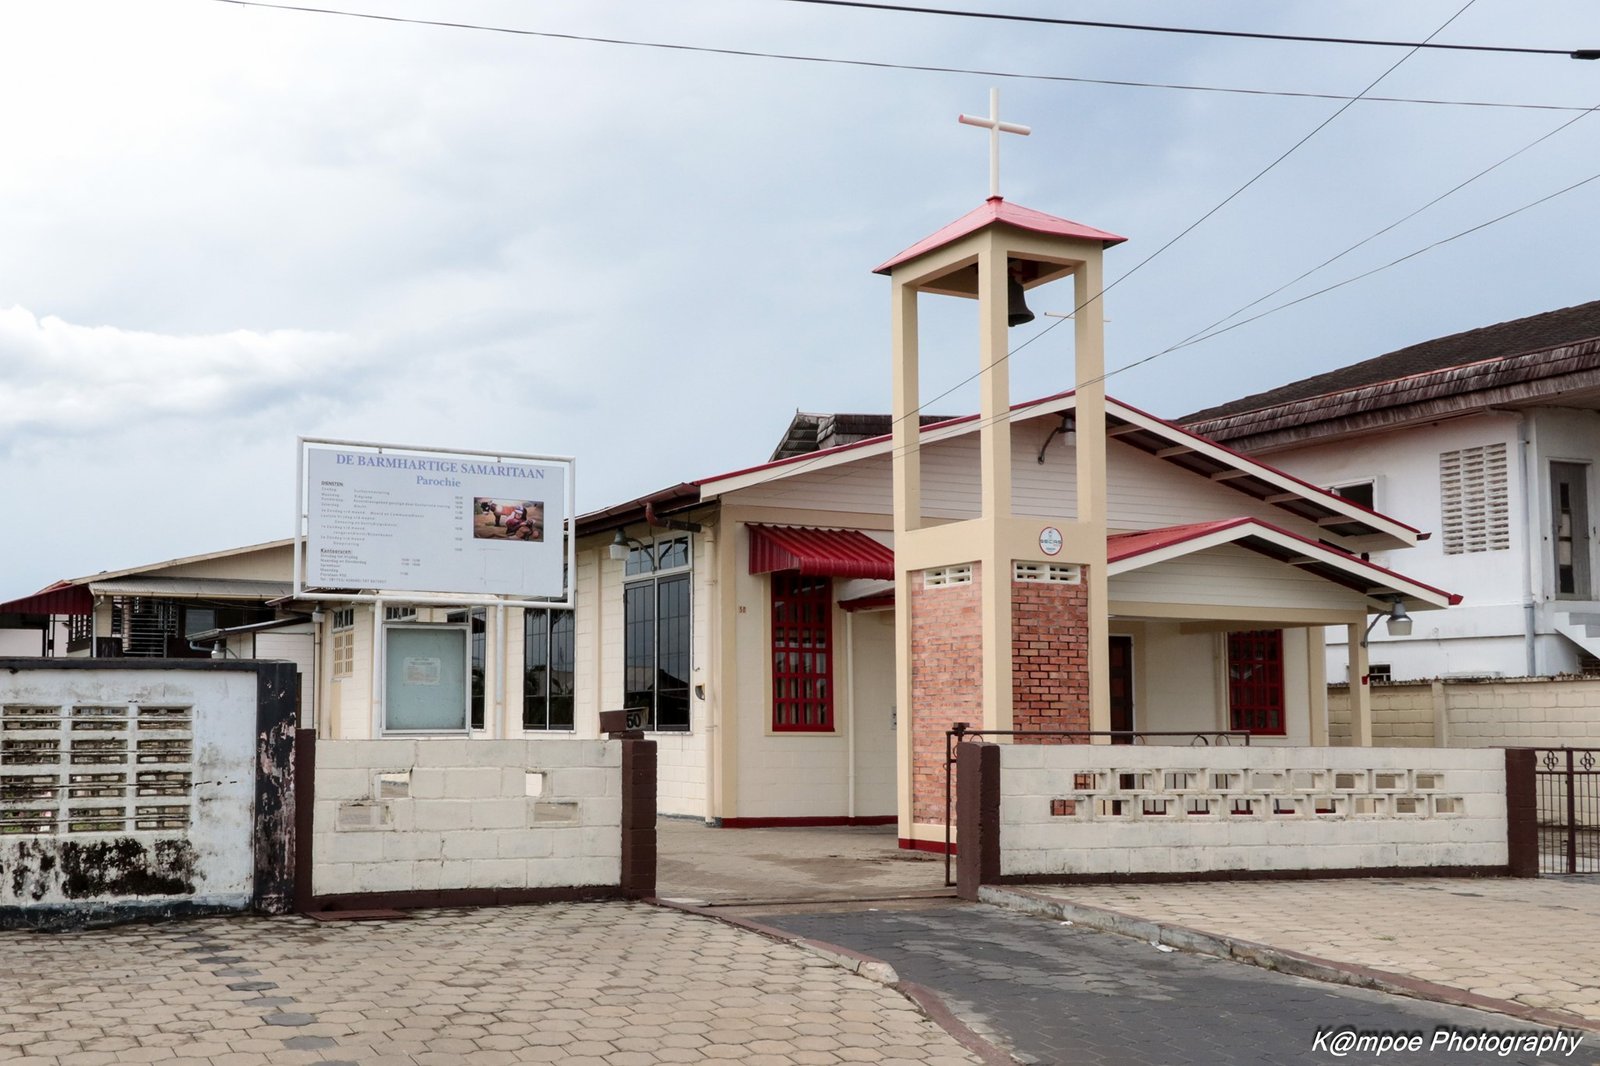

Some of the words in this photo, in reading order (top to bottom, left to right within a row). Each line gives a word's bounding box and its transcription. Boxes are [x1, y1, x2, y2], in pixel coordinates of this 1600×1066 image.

[336, 453, 355, 466] DE
[357, 455, 459, 473] BARMHARTIGE
[461, 463, 546, 480] SAMARITAAN
[416, 475, 462, 488] Parochie
[626, 713, 642, 729] 50
